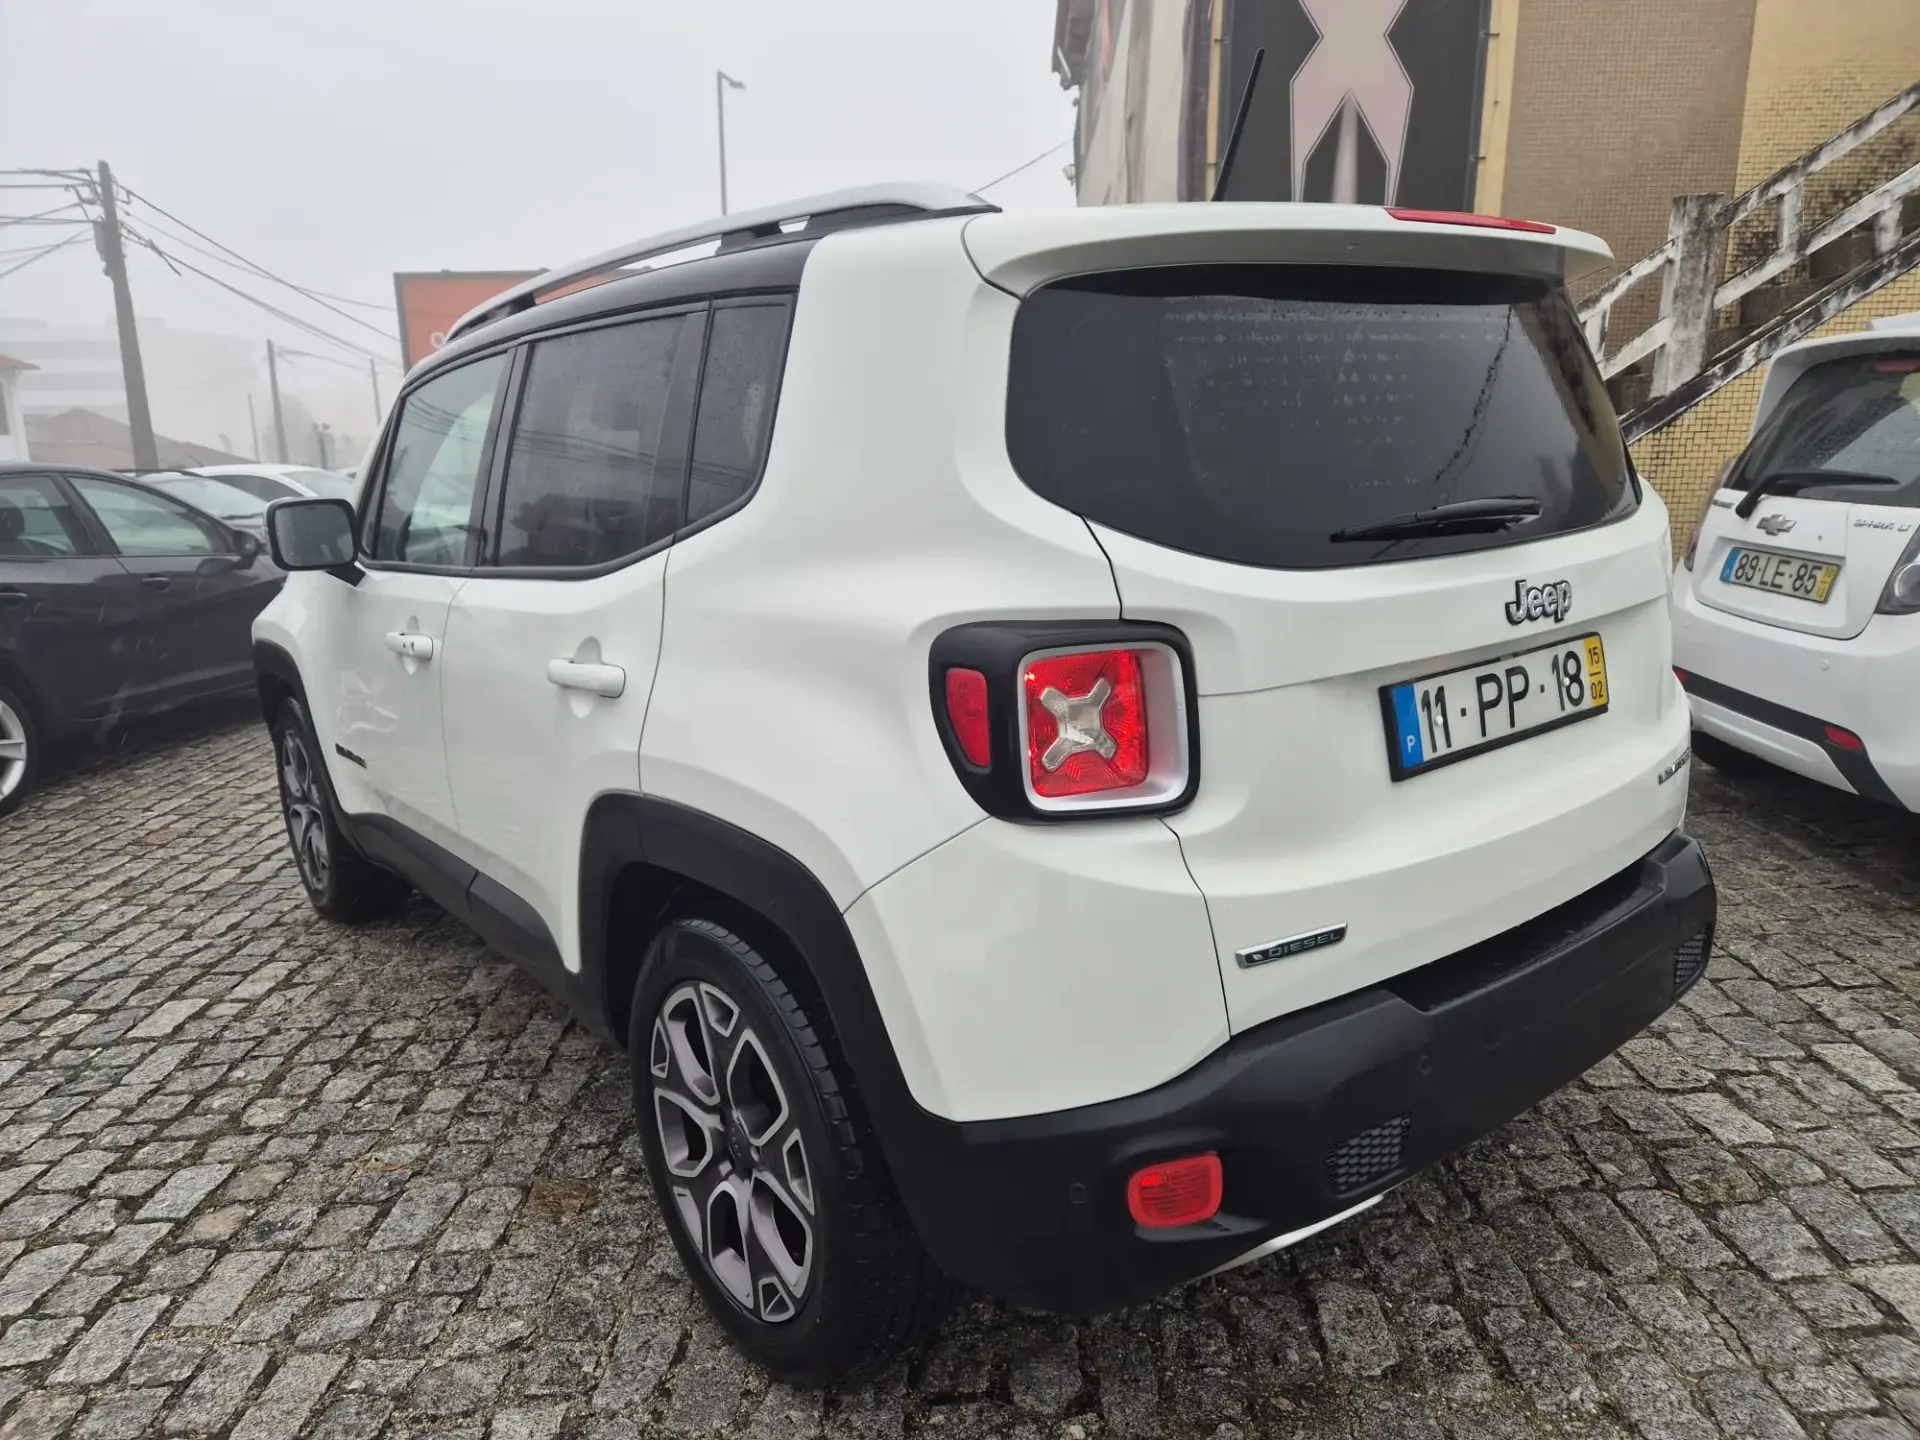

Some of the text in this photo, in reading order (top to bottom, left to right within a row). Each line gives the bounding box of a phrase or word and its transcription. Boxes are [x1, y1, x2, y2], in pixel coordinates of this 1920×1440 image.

[1505, 579, 1573, 627] Jeep
[1587, 646, 1600, 667] 15
[1590, 679, 1604, 701] 02
[1406, 734, 1416, 753] P
[1267, 932, 1341, 958] DIESEL
